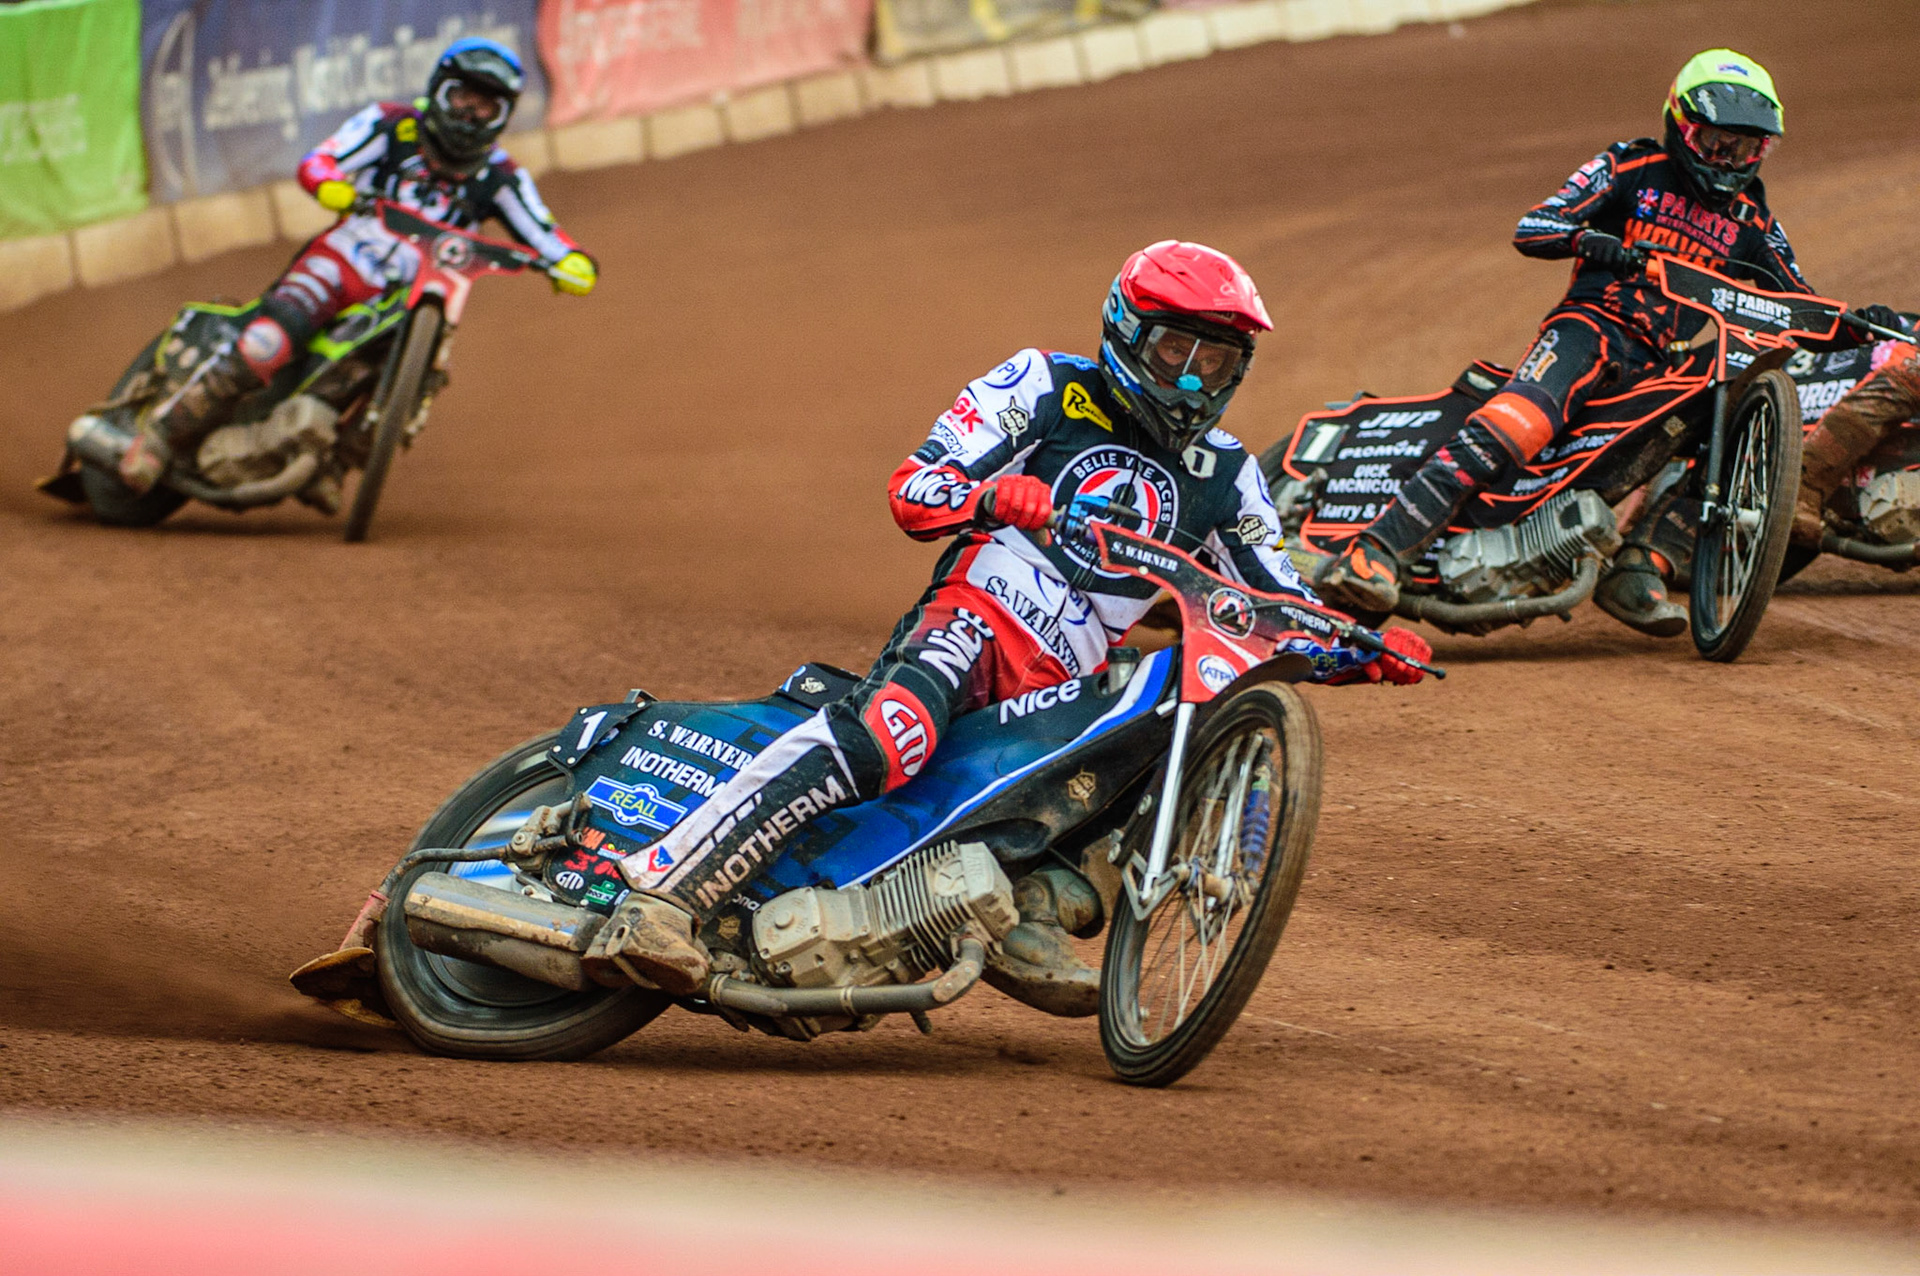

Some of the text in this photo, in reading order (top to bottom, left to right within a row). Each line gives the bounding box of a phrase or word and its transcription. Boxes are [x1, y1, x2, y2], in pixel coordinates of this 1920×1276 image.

[1736, 292, 1792, 322] PARRYS
[1358, 410, 1442, 429] JWP
[1301, 423, 1341, 461] 1
[1072, 452, 1118, 479] BELLE
[1155, 479, 1173, 523] ACES
[1125, 544, 1179, 573] WARNER
[576, 710, 608, 751] 1
[647, 719, 669, 740] S.
[620, 745, 726, 799] INOTHERM
[609, 789, 660, 819] REALL
[695, 774, 847, 910] INOTHERM
